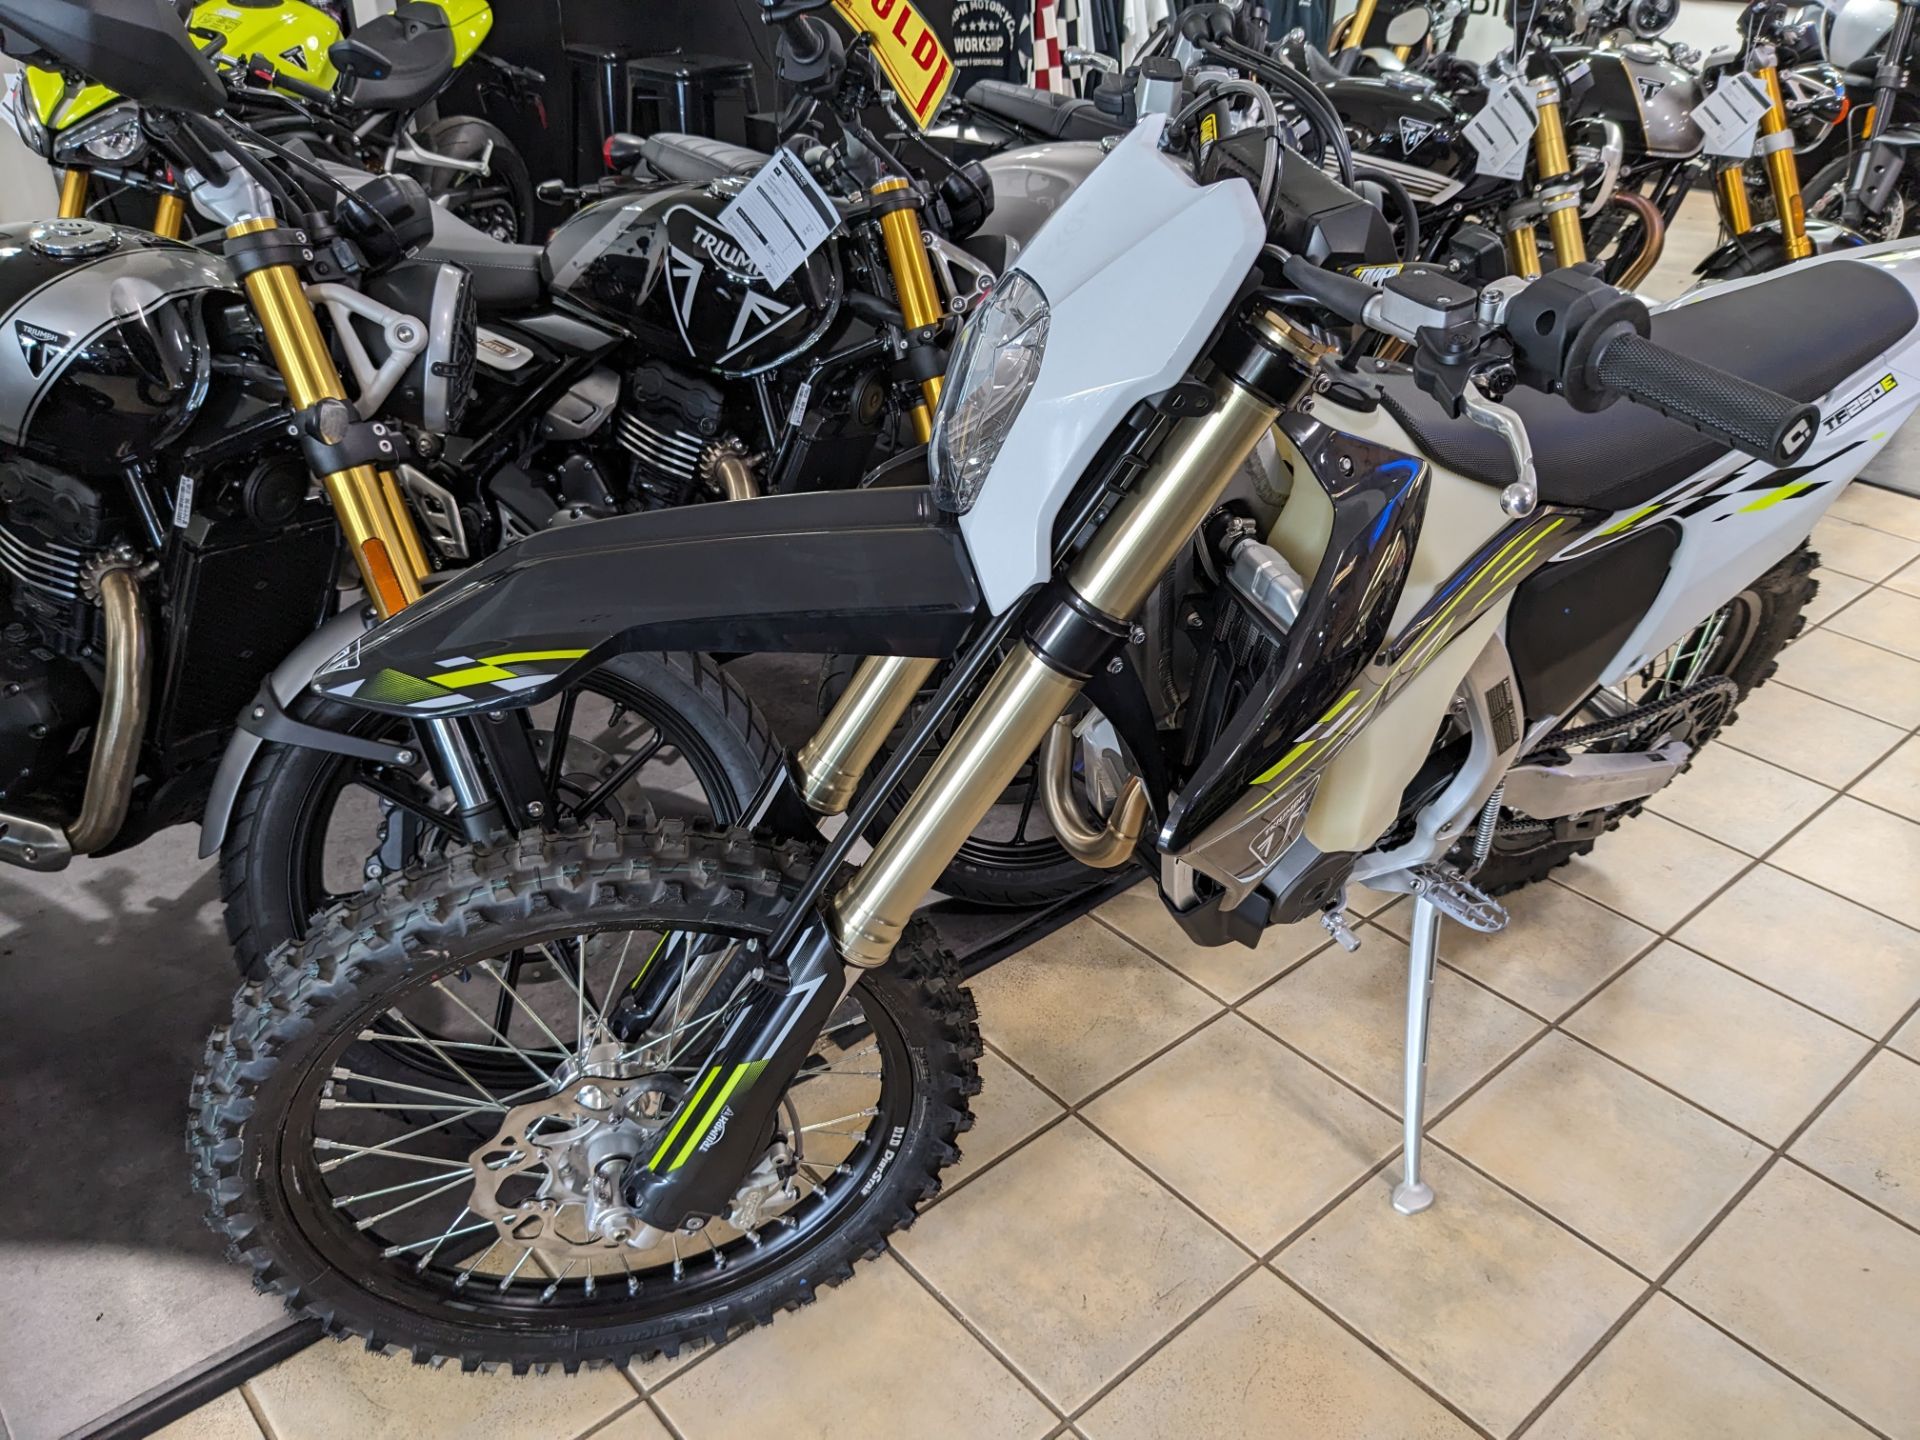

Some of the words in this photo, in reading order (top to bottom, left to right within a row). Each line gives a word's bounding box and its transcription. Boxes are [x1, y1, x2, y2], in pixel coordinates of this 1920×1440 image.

[692, 225, 763, 277] TRIUM
[23, 324, 59, 342] TRIUMPH
[698, 1114, 729, 1152] TRIUMPH
